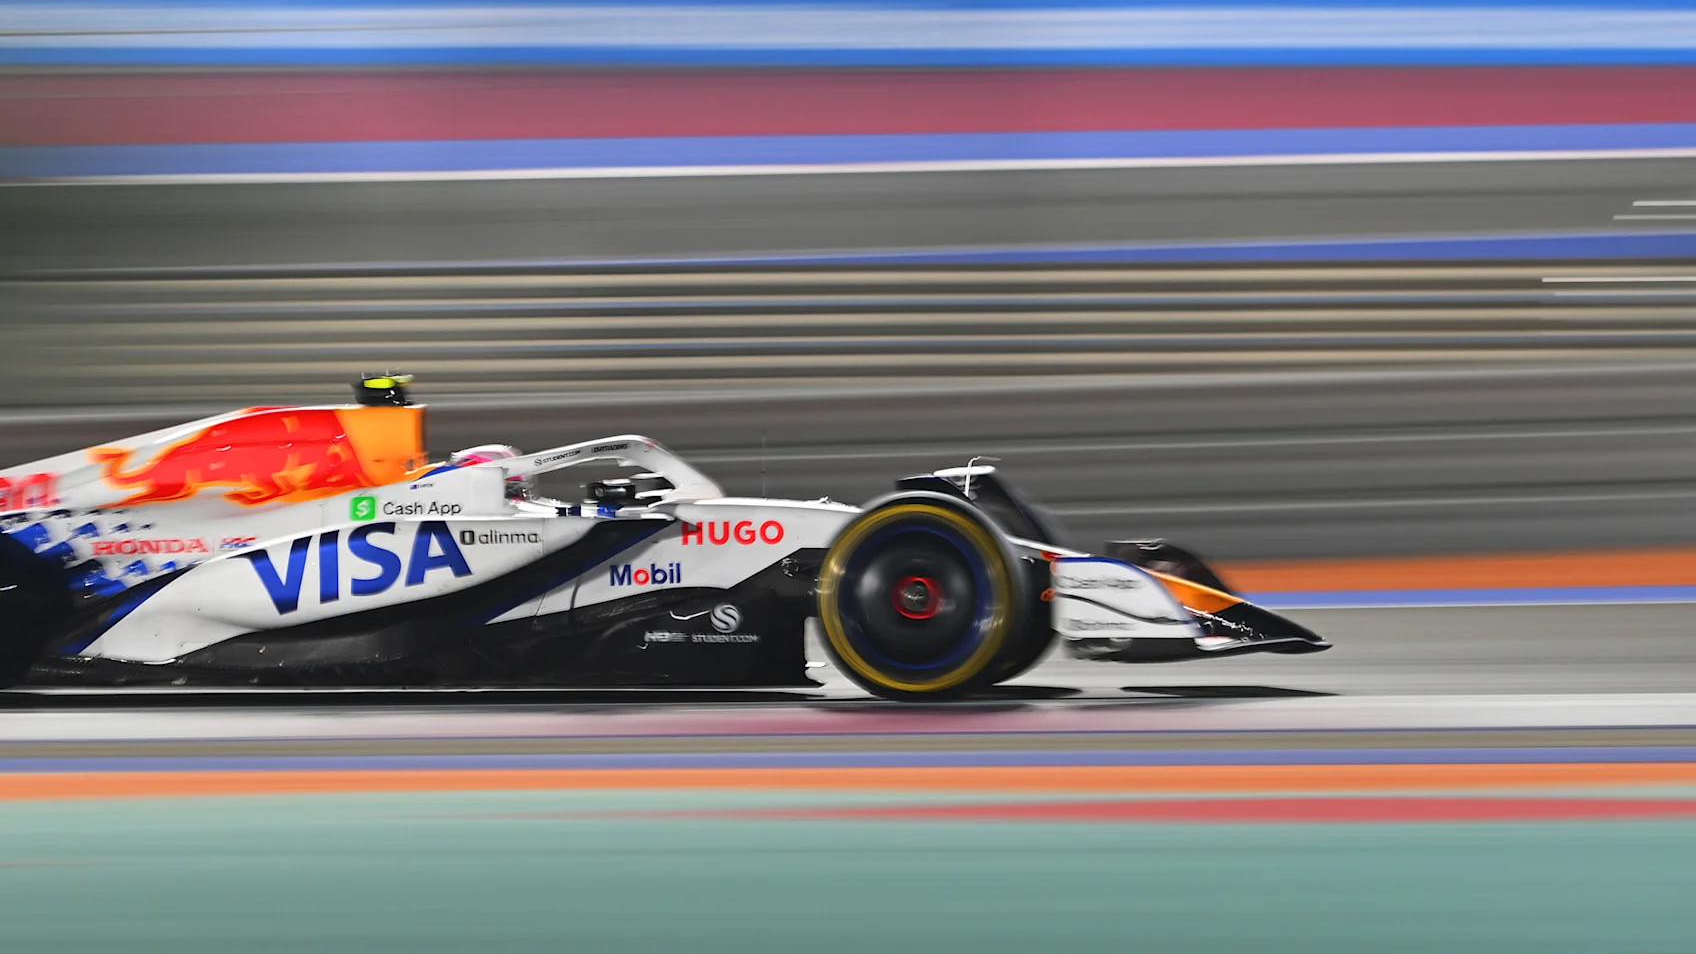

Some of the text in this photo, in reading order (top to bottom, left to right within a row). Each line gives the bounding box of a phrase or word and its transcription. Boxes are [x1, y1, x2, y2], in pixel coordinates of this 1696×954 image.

[383, 501, 423, 516] Cash
[428, 501, 462, 517] App
[478, 530, 540, 545] alinma
[681, 520, 785, 546] HUGO
[90, 537, 209, 557] HONDA
[229, 521, 473, 616] VISA
[609, 562, 681, 587] Mobil
